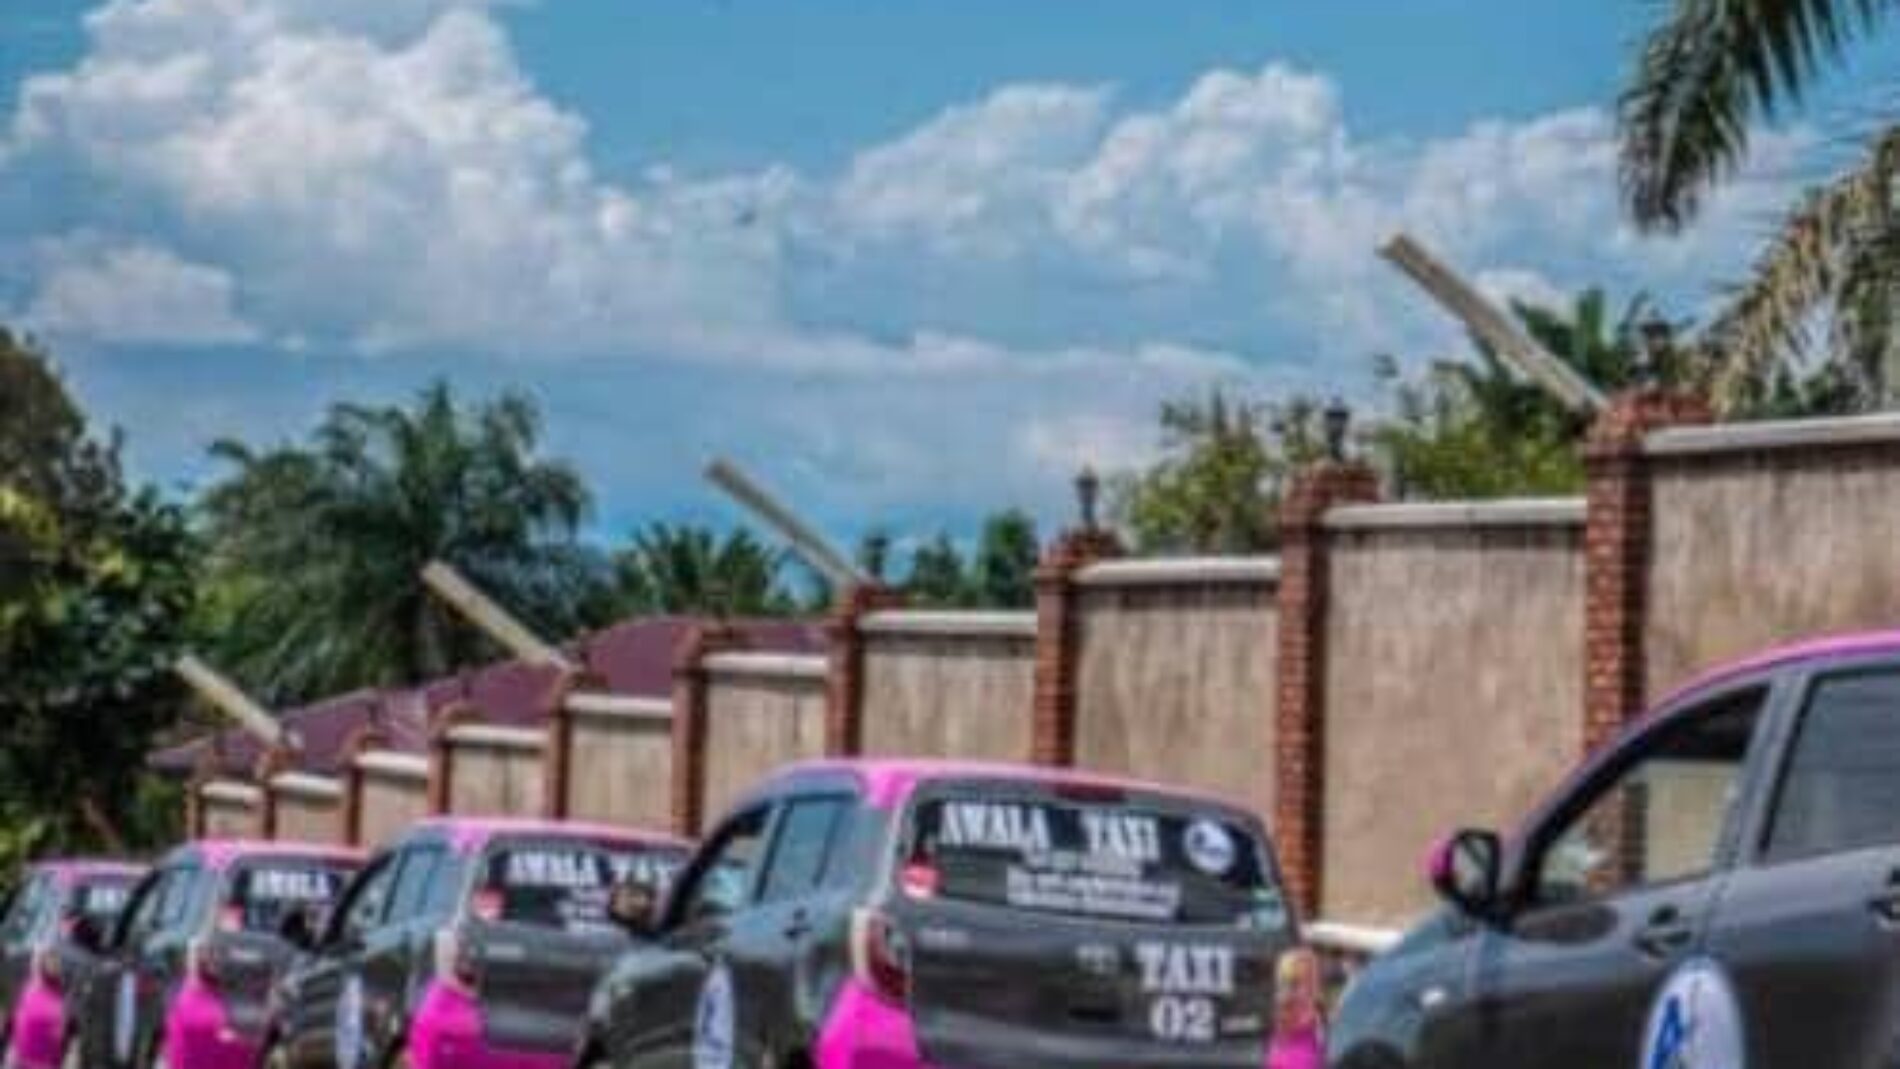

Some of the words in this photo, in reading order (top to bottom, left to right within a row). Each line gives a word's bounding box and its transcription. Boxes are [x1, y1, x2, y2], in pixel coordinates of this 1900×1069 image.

[940, 801, 1050, 849] AWALA
[1081, 811, 1160, 861] TAXI
[507, 851, 599, 886] AWALA
[1135, 943, 1235, 992] TAXI
[1151, 997, 1215, 1041] 02
